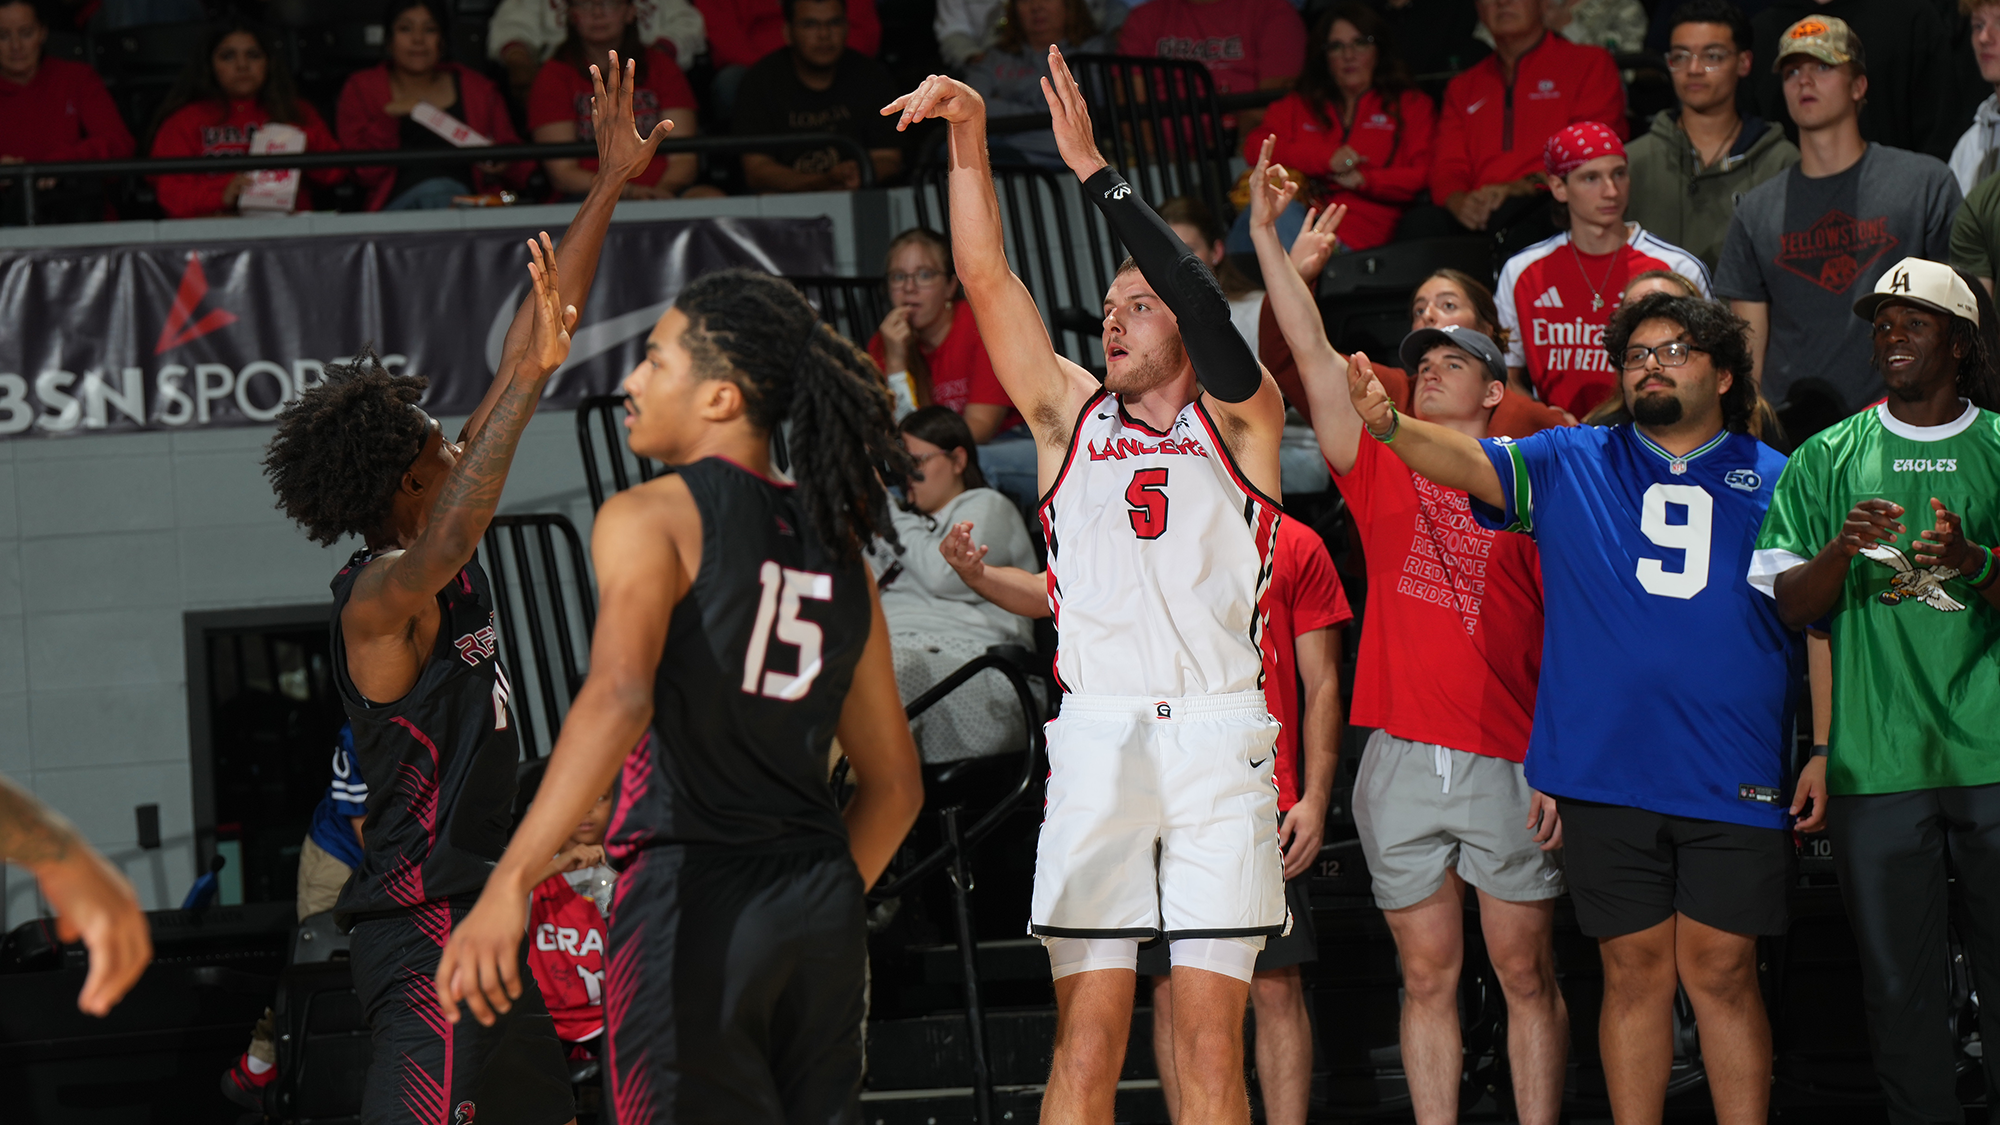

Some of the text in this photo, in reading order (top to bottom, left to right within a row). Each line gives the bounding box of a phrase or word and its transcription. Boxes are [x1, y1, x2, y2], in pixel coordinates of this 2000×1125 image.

[1779, 216, 1888, 253] YELLOWSTONE
[1532, 316, 1607, 346] Emira
[1547, 347, 1615, 373] FLY BETT
[0, 367, 147, 433] BSN
[1725, 471, 1761, 490] 50
[1892, 458, 1957, 472] EAGLES
[1125, 467, 1169, 540] 5
[1636, 482, 1713, 600] 9
[741, 559, 833, 702] 15
[1811, 839, 1831, 856] 10
[1319, 860, 1340, 876] 12
[536, 923, 604, 956] GRA
